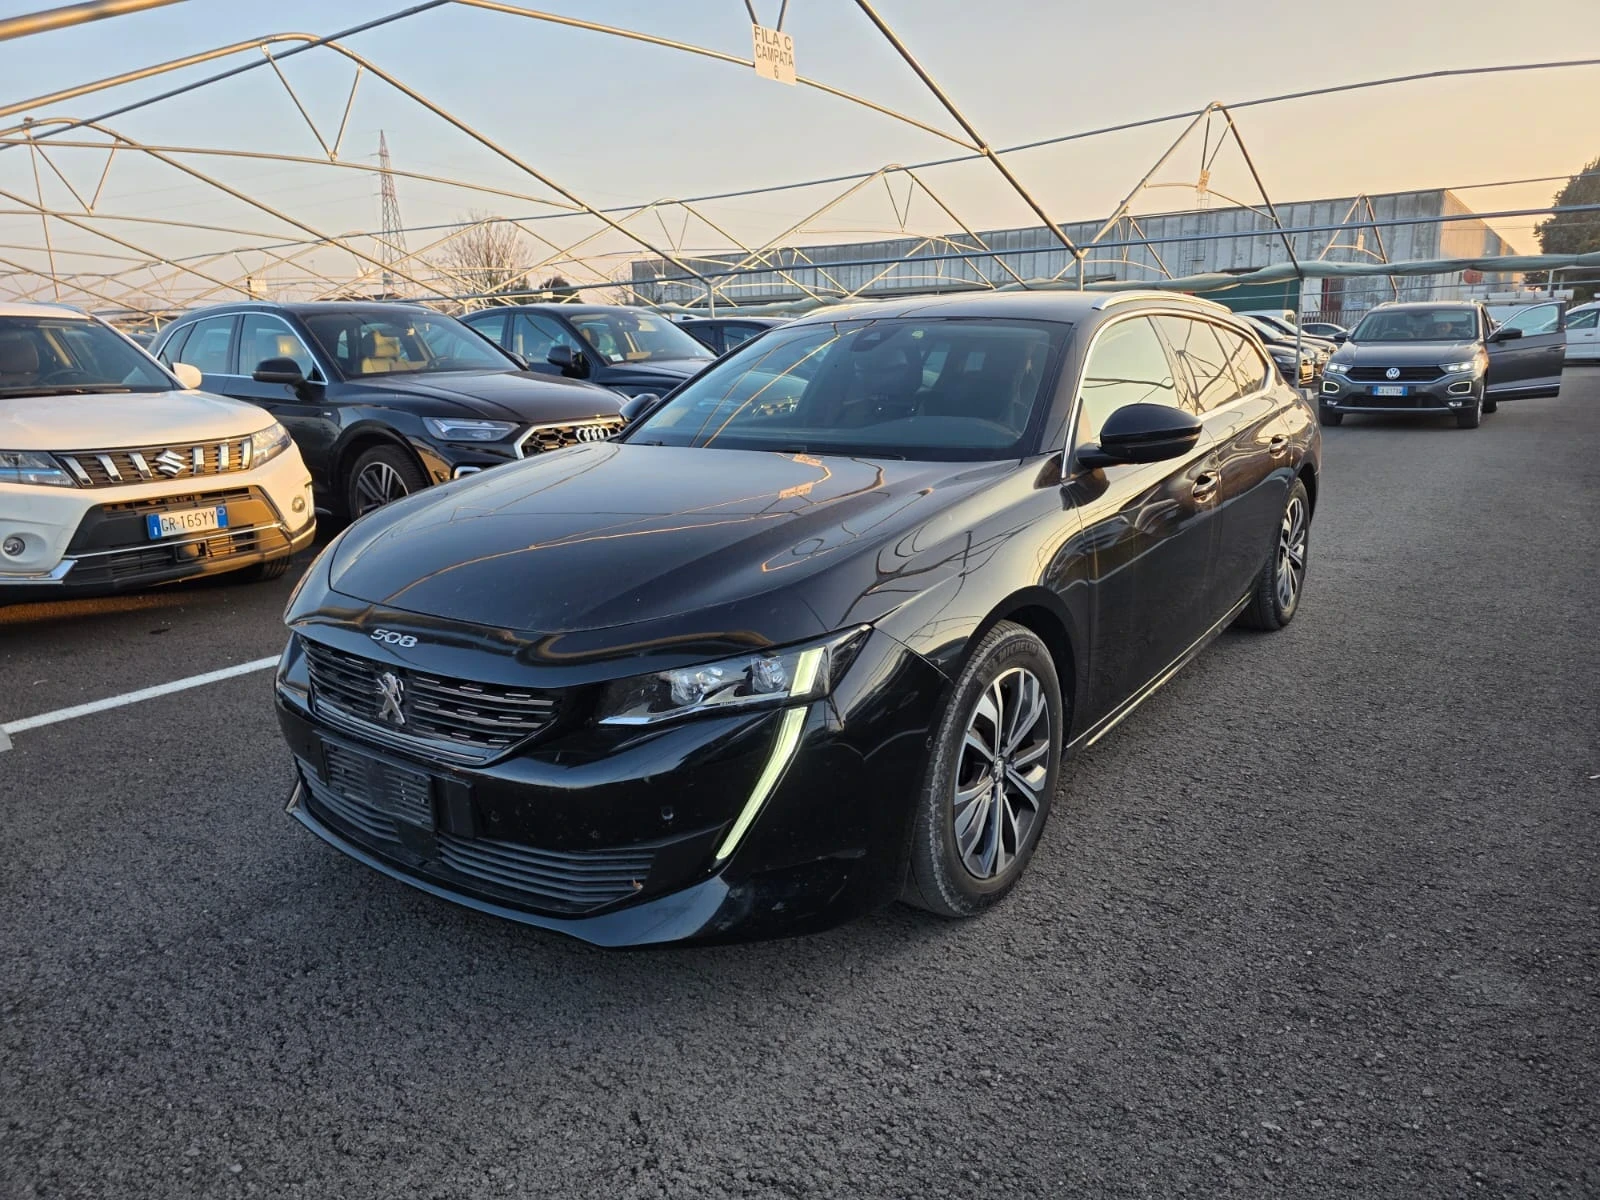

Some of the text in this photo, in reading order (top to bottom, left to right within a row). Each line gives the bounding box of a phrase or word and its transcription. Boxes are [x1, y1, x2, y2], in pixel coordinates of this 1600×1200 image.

[754, 26, 792, 51] FILA C
[755, 43, 794, 67] CAMPATA
[774, 65, 779, 79] 6
[370, 628, 418, 648] 508
